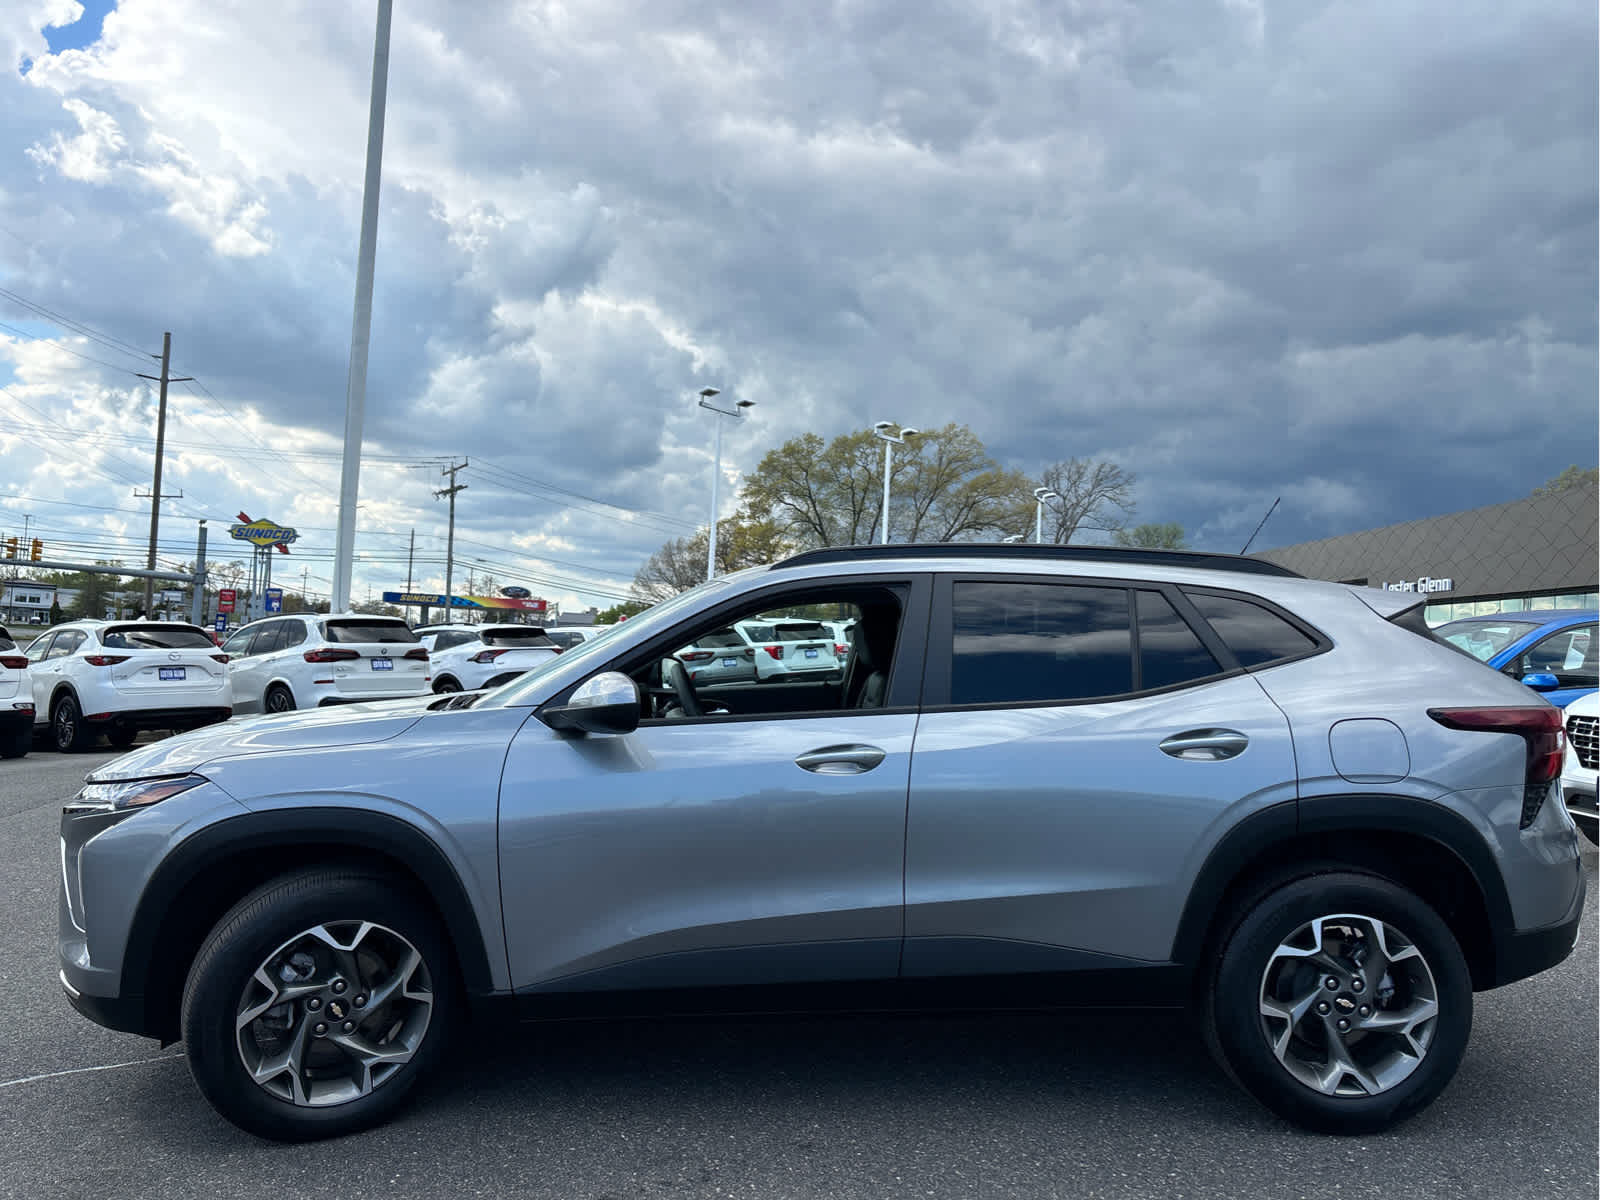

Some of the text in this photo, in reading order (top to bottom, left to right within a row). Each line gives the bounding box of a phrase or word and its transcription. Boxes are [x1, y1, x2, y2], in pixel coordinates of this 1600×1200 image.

[235, 527, 291, 539] SUNOCO
[1418, 576, 1453, 592] Glenn
[400, 594, 438, 602] SUNOCO
